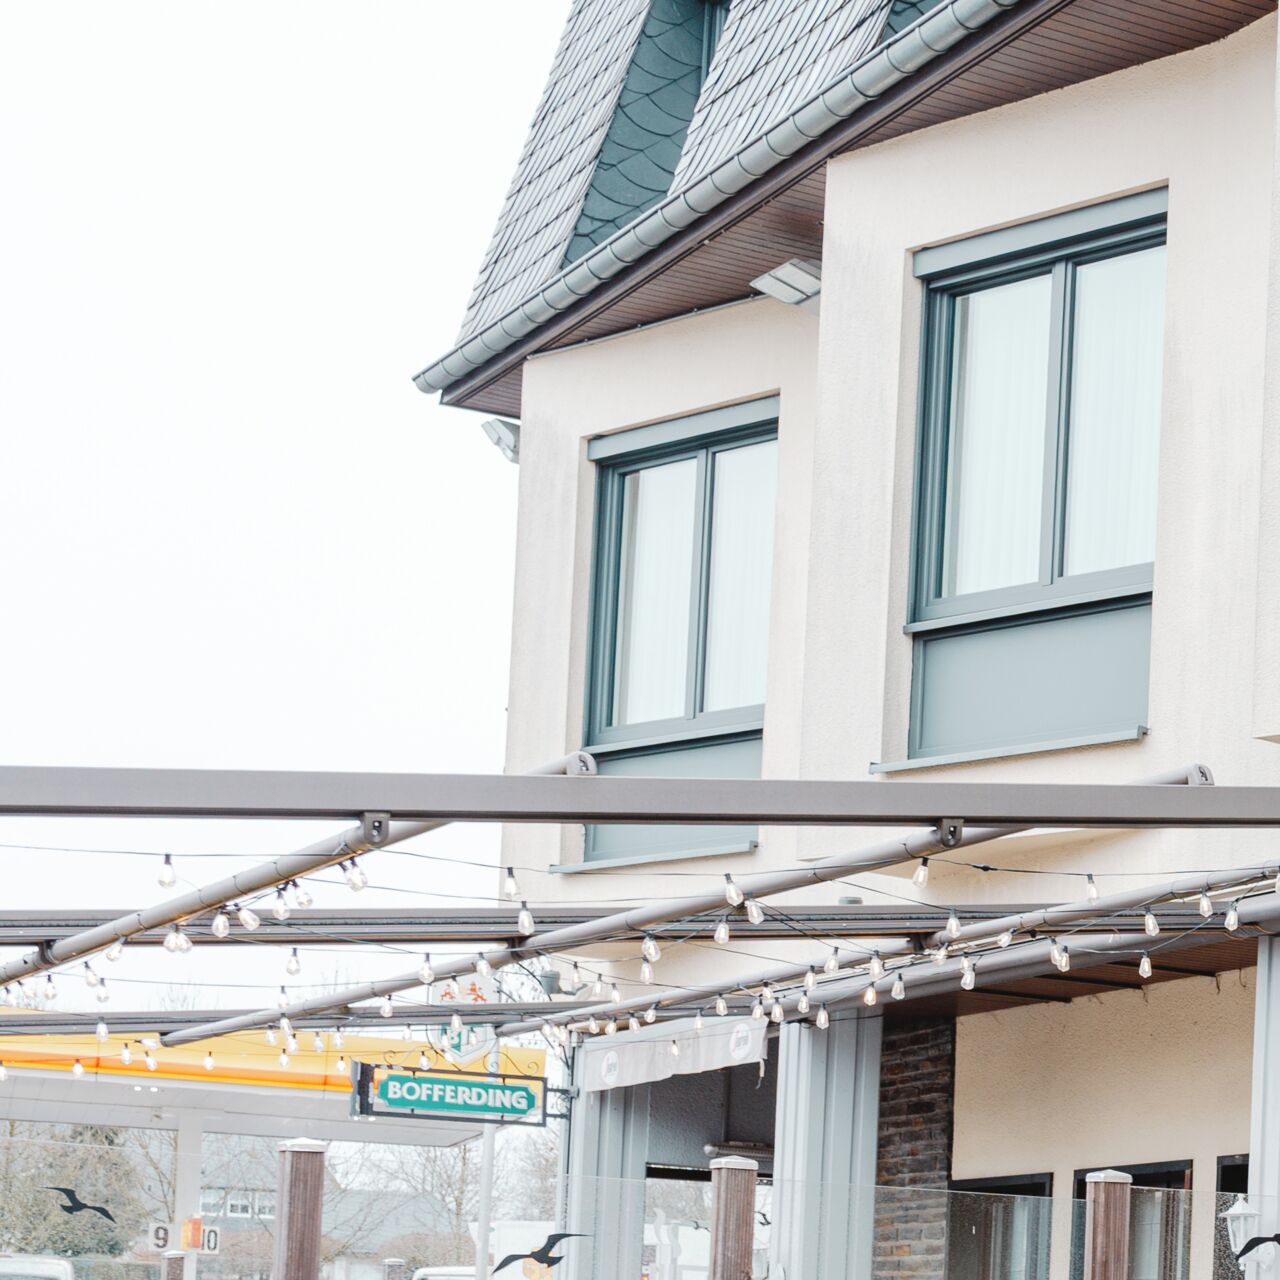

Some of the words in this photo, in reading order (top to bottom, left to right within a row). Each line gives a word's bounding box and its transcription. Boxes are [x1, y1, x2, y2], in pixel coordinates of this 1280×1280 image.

[387, 1080, 529, 1111] BOFFERDING
[154, 1225, 169, 1249] 9
[202, 1228, 219, 1252] 10
